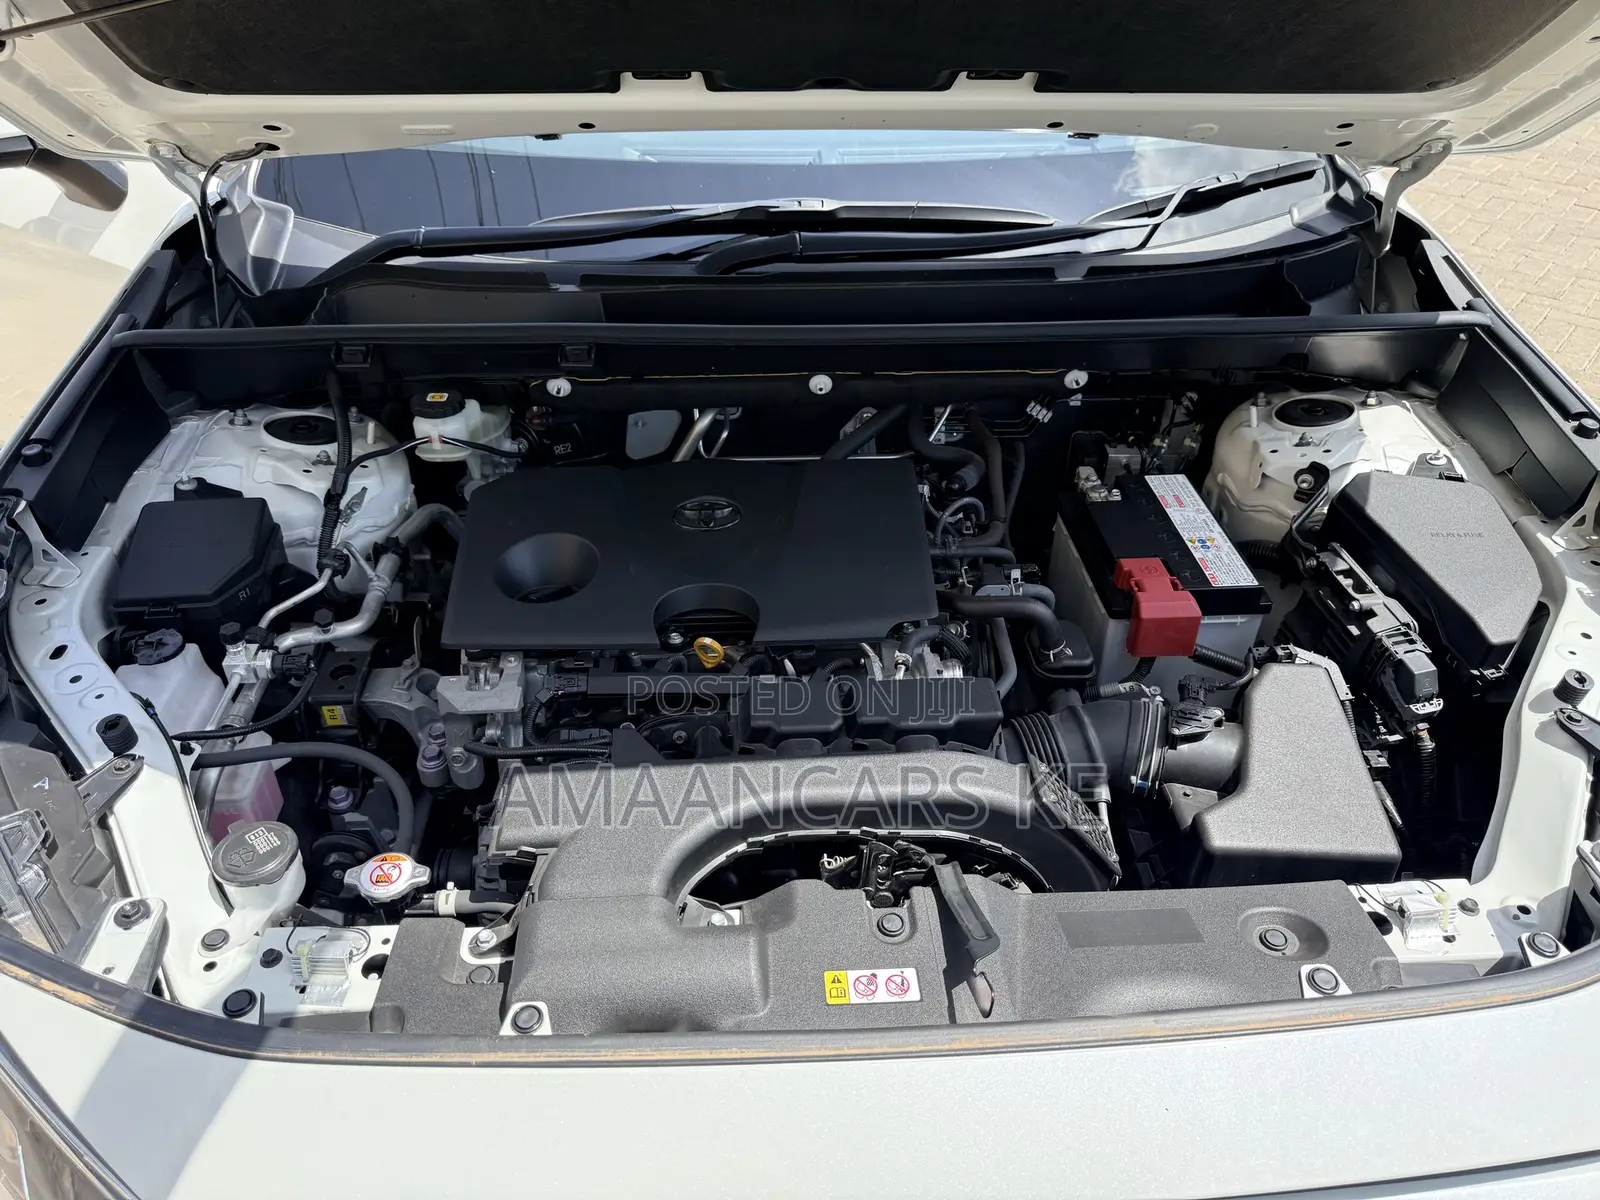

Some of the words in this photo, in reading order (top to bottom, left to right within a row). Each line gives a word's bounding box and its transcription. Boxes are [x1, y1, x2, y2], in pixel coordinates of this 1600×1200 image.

[554, 443, 572, 455] RE2
[238, 588, 250, 600] R1
[327, 708, 338, 720] R4
